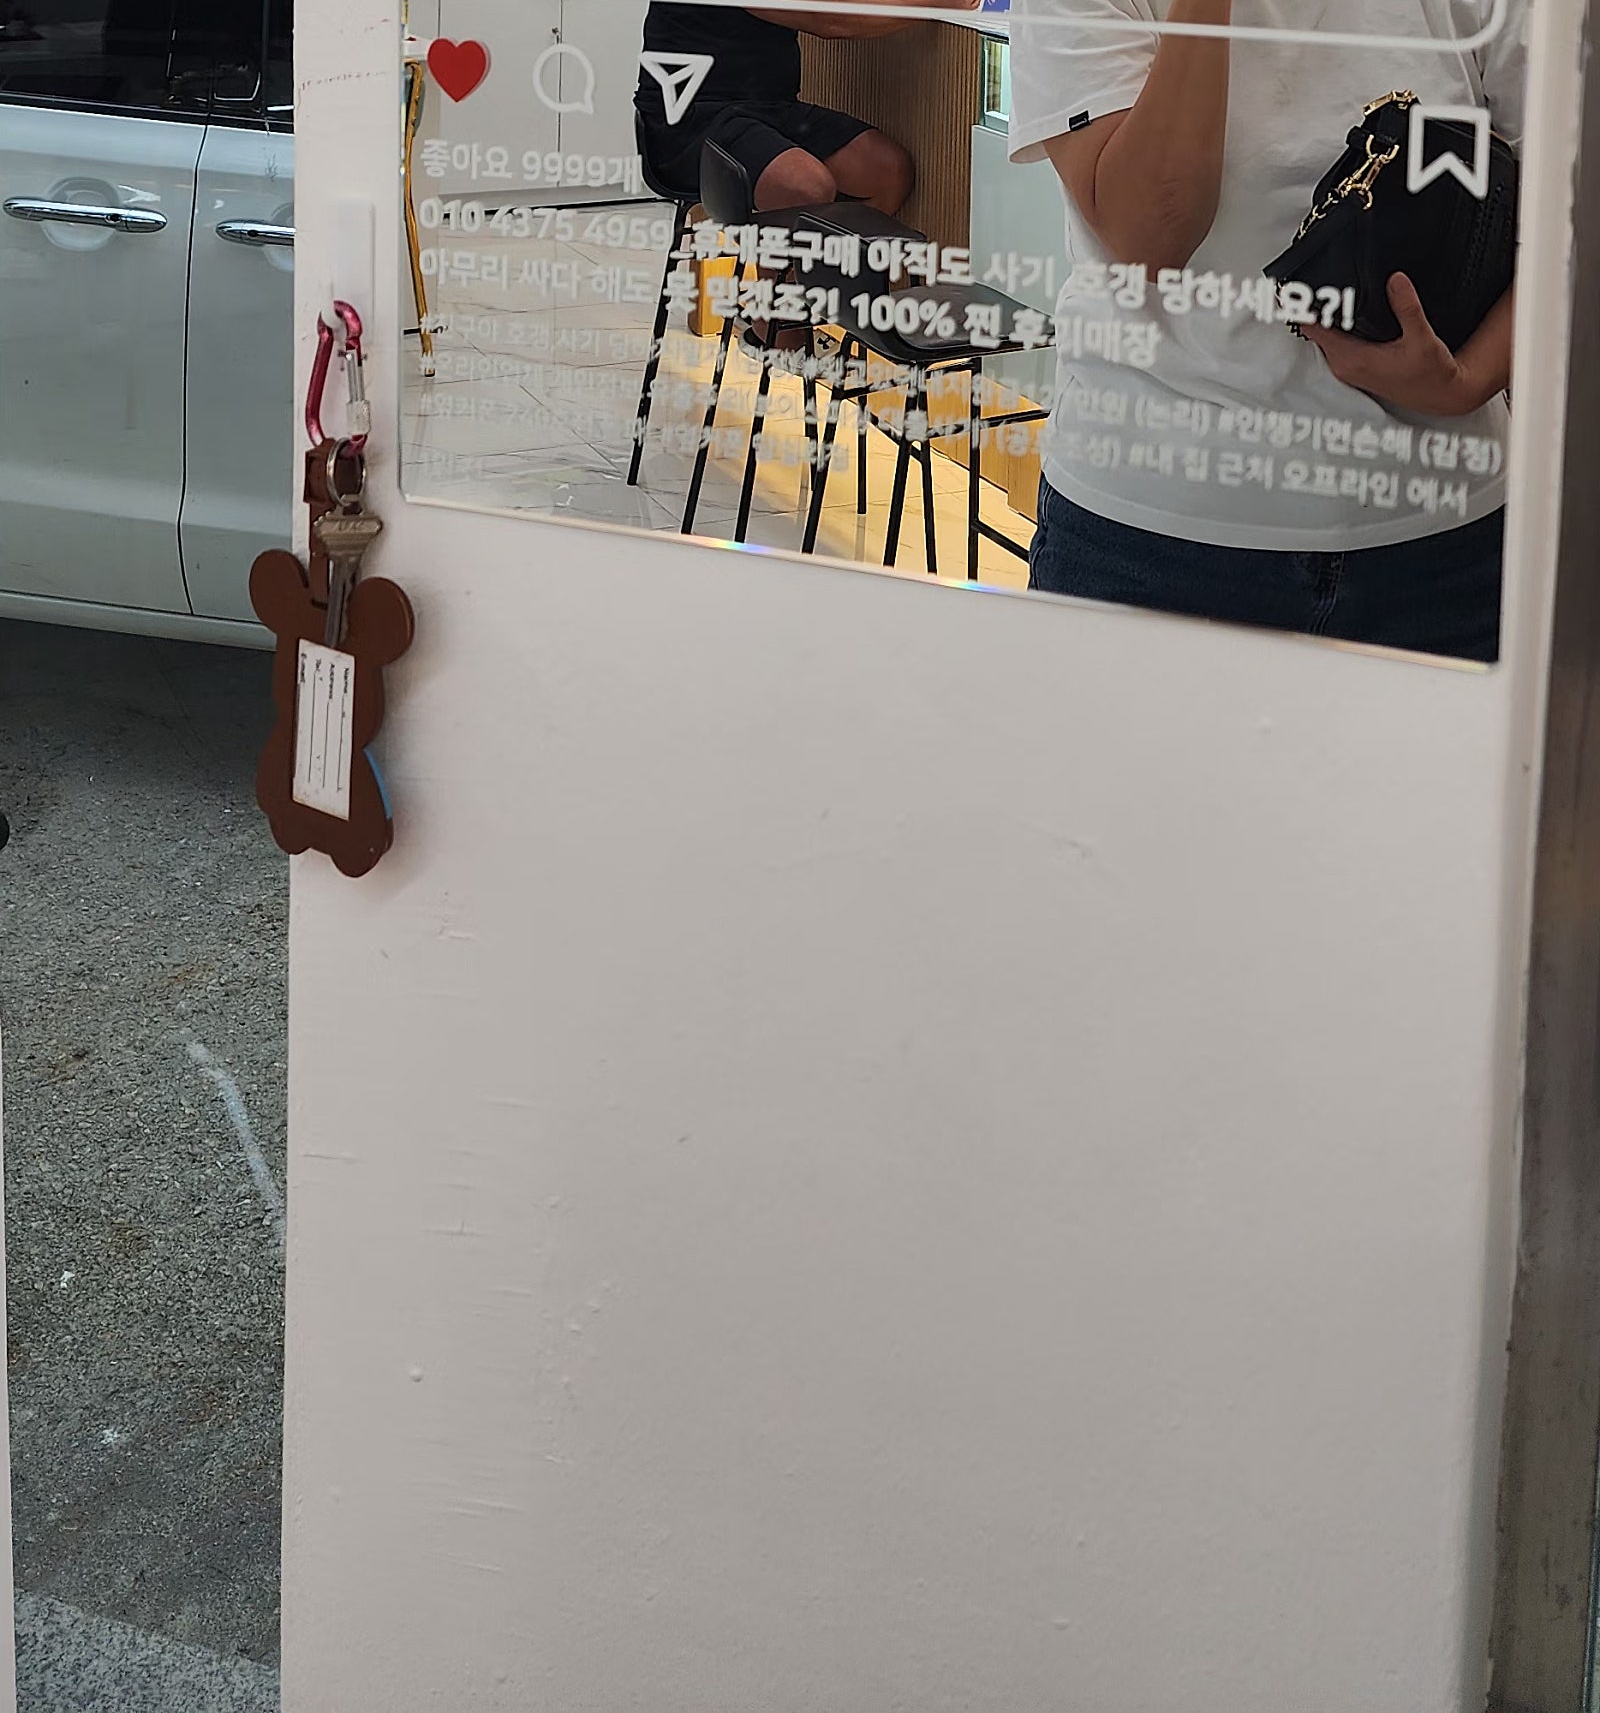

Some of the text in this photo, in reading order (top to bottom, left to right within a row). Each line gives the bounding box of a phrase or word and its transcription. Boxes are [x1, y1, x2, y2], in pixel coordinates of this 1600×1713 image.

[420, 138, 642, 195] 좋아요 9999개
[420, 201, 484, 234] 010
[489, 207, 576, 244] 4375
[867, 238, 976, 287] 아직도
[983, 249, 1056, 295] 사기
[1156, 267, 1356, 332] 당하세요?!
[420, 248, 509, 290] 아무리
[519, 260, 581, 302] 싸다
[592, 265, 655, 304] 해도
[663, 270, 699, 316] 못
[706, 273, 840, 326] 믿겠죠?!
[850, 291, 957, 339] 100%
[963, 303, 1002, 352] 찐
